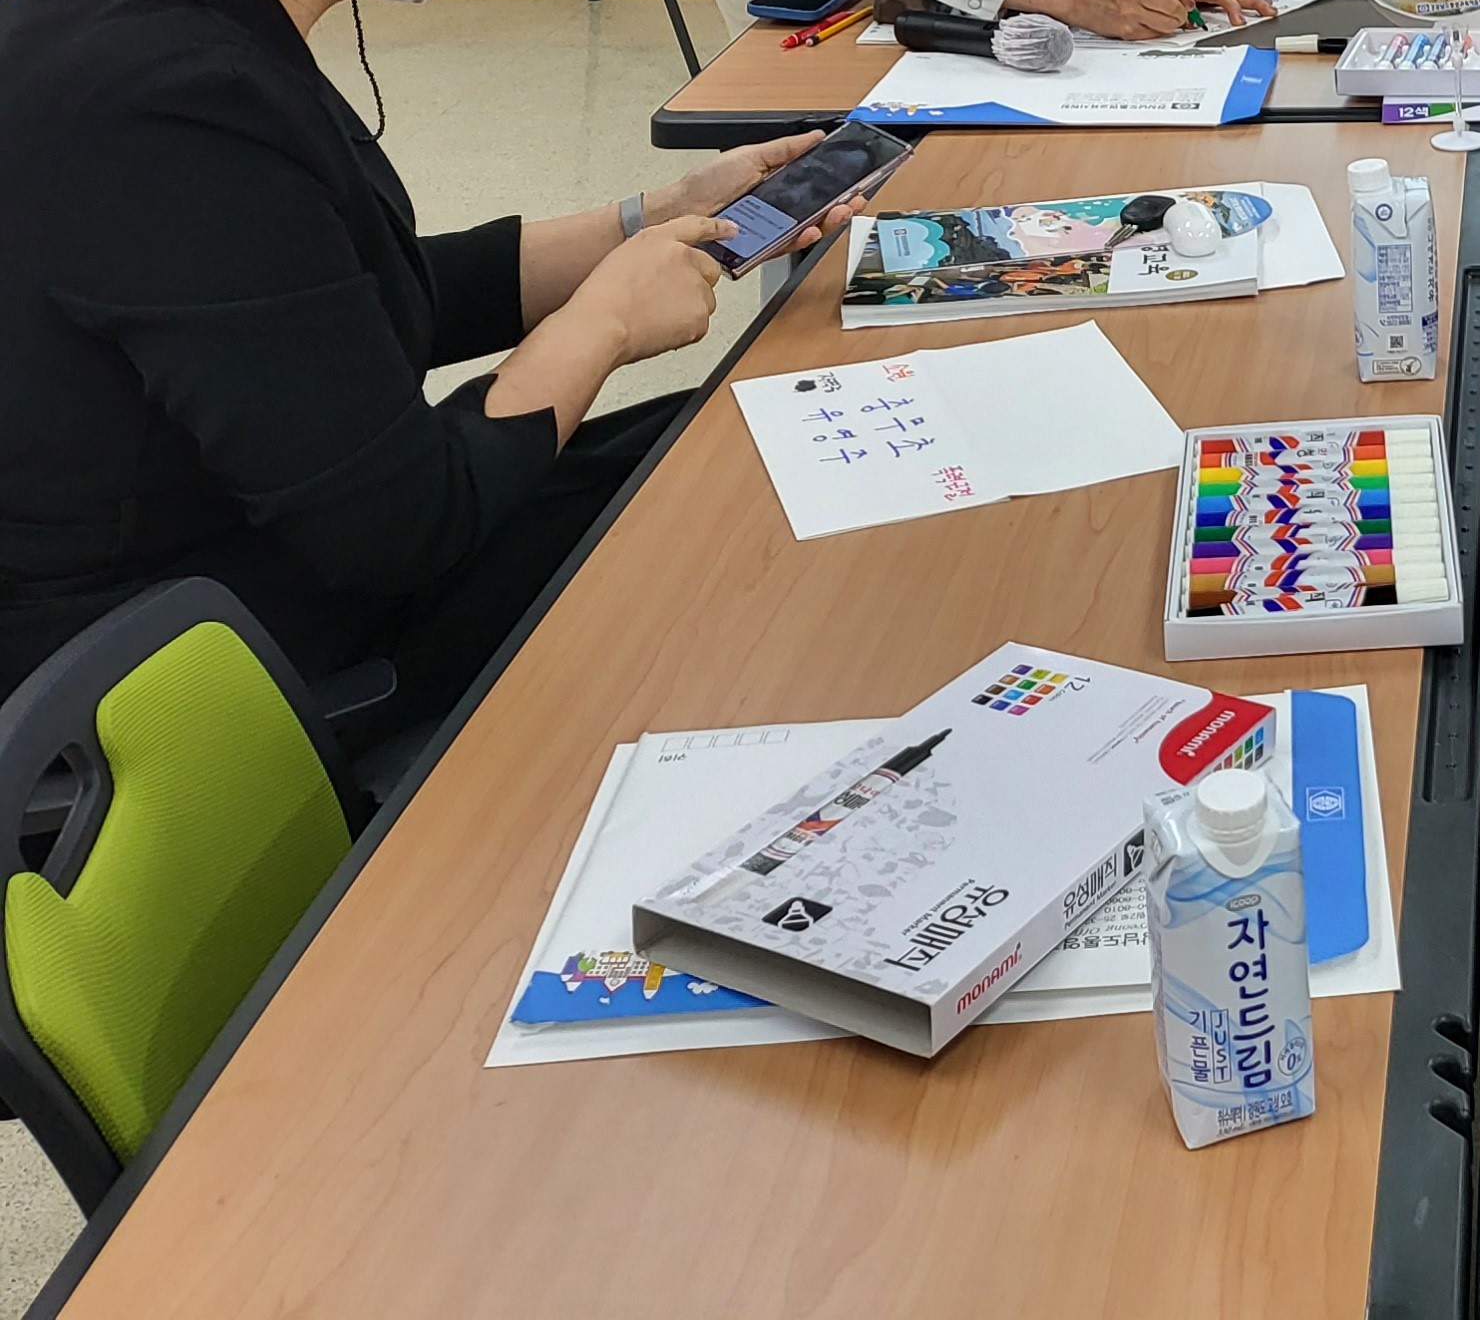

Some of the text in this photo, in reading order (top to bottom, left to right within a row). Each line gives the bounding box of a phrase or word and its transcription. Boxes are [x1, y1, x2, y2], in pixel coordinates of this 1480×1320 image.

[1398, 106, 1429, 118] 12색
[1183, 708, 1235, 758] monami
[1063, 854, 1117, 919] 유성매직
[884, 883, 1009, 971] 유성매직
[956, 943, 1021, 1014] monami
[1228, 909, 1275, 1088] 자연드림
[1189, 1011, 1210, 1082] 기픈물
[1214, 1012, 1228, 1080] JUST
